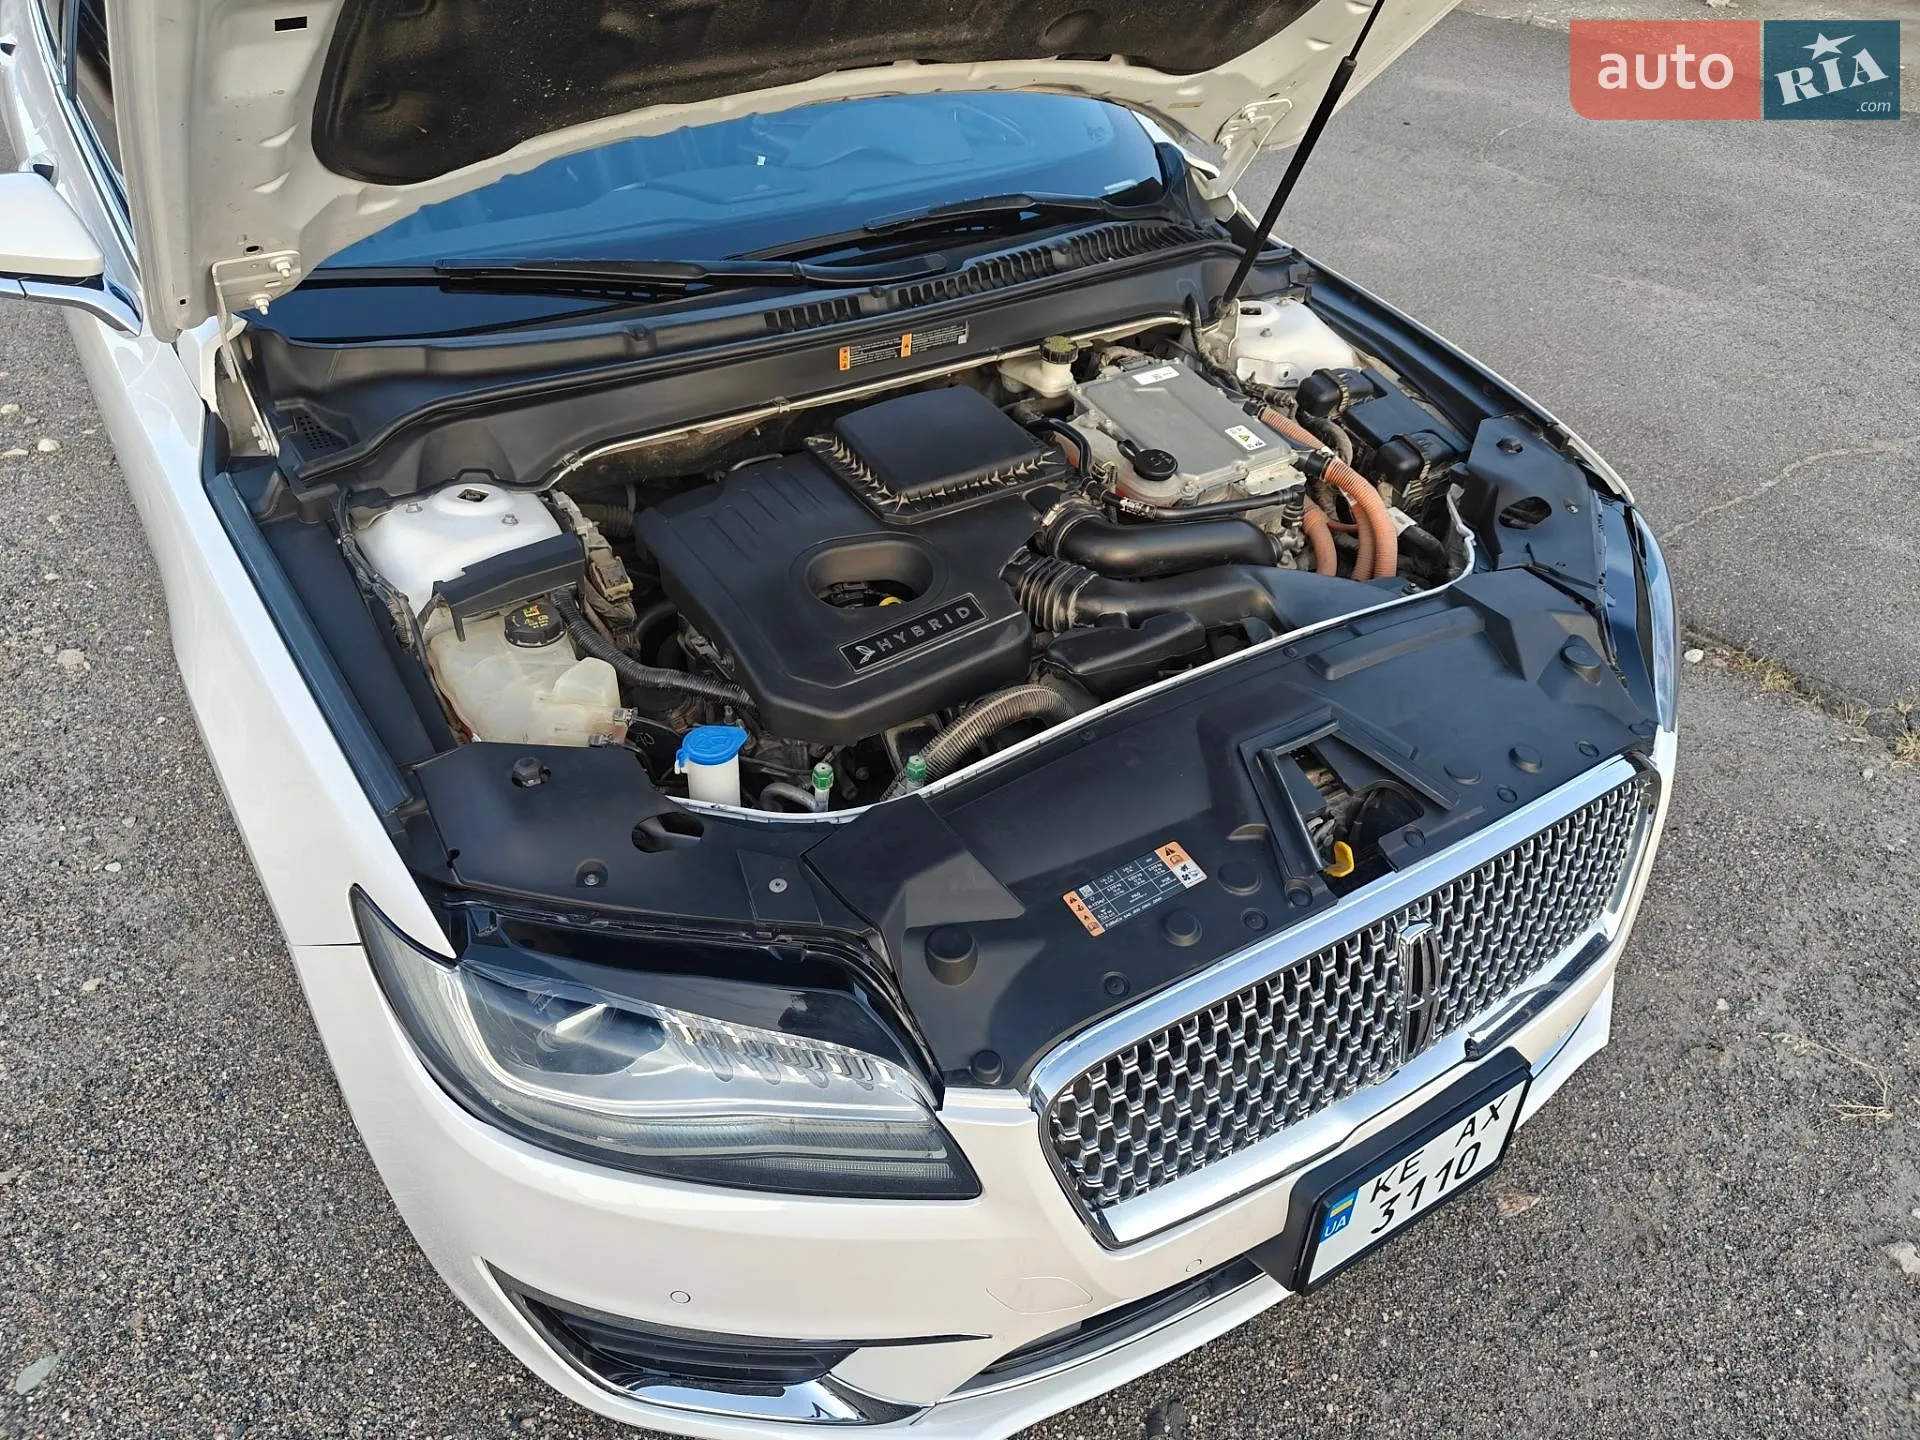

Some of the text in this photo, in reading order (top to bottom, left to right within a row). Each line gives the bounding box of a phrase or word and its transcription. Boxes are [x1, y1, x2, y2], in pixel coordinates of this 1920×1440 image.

[876, 606, 971, 652] HYBRID
[1370, 1094, 1508, 1203] KE AX
[1371, 1141, 1482, 1234] 3110
[1324, 1215, 1346, 1237] UA
